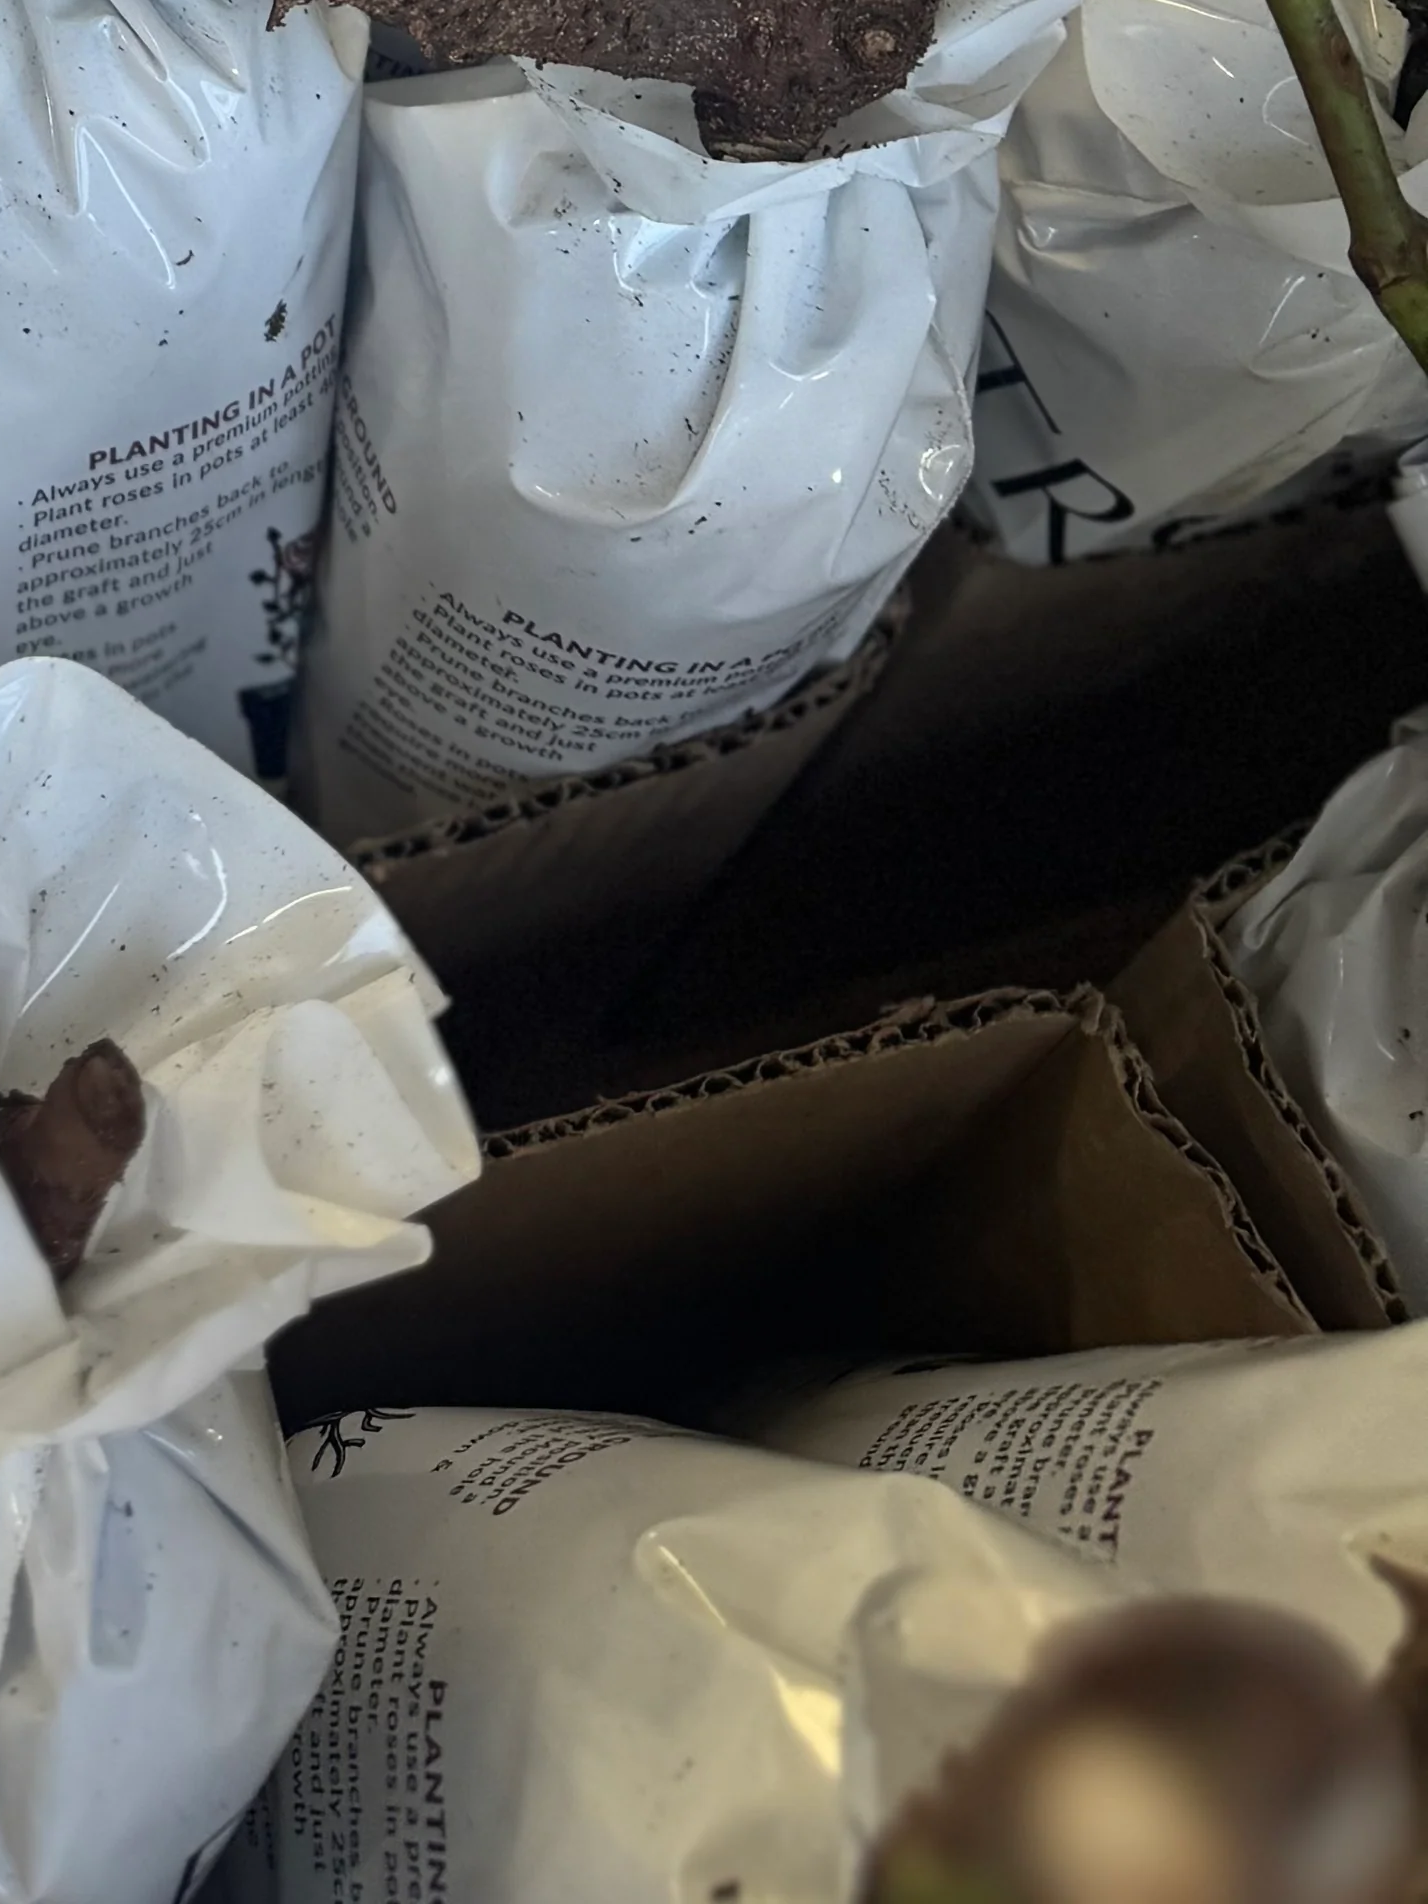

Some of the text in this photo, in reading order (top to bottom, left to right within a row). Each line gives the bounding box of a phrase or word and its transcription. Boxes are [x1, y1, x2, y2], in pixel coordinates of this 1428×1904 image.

[87, 313, 339, 471] PLANTING IN A POT
[31, 403, 280, 508] Always use premium
[32, 392, 314, 529] Plant roses pots least
[15, 511, 242, 595] approximately 25cm
[17, 511, 130, 555] diameter.
[106, 475, 264, 552] branches back
[114, 570, 195, 613] growth
[440, 592, 576, 670] Always use
[397, 637, 565, 731] approximately
[412, 608, 519, 684] diameter.
[502, 608, 679, 677] PLANTING
[474, 725, 564, 762] growth
[1059, 1444, 1098, 1515] roses
[366, 1578, 403, 1734] diameter.
[407, 1597, 437, 1717] Always
[347, 1705, 362, 1867] branches
[385, 1696, 401, 1790] roses
[424, 1680, 448, 1904] PLANTIN
